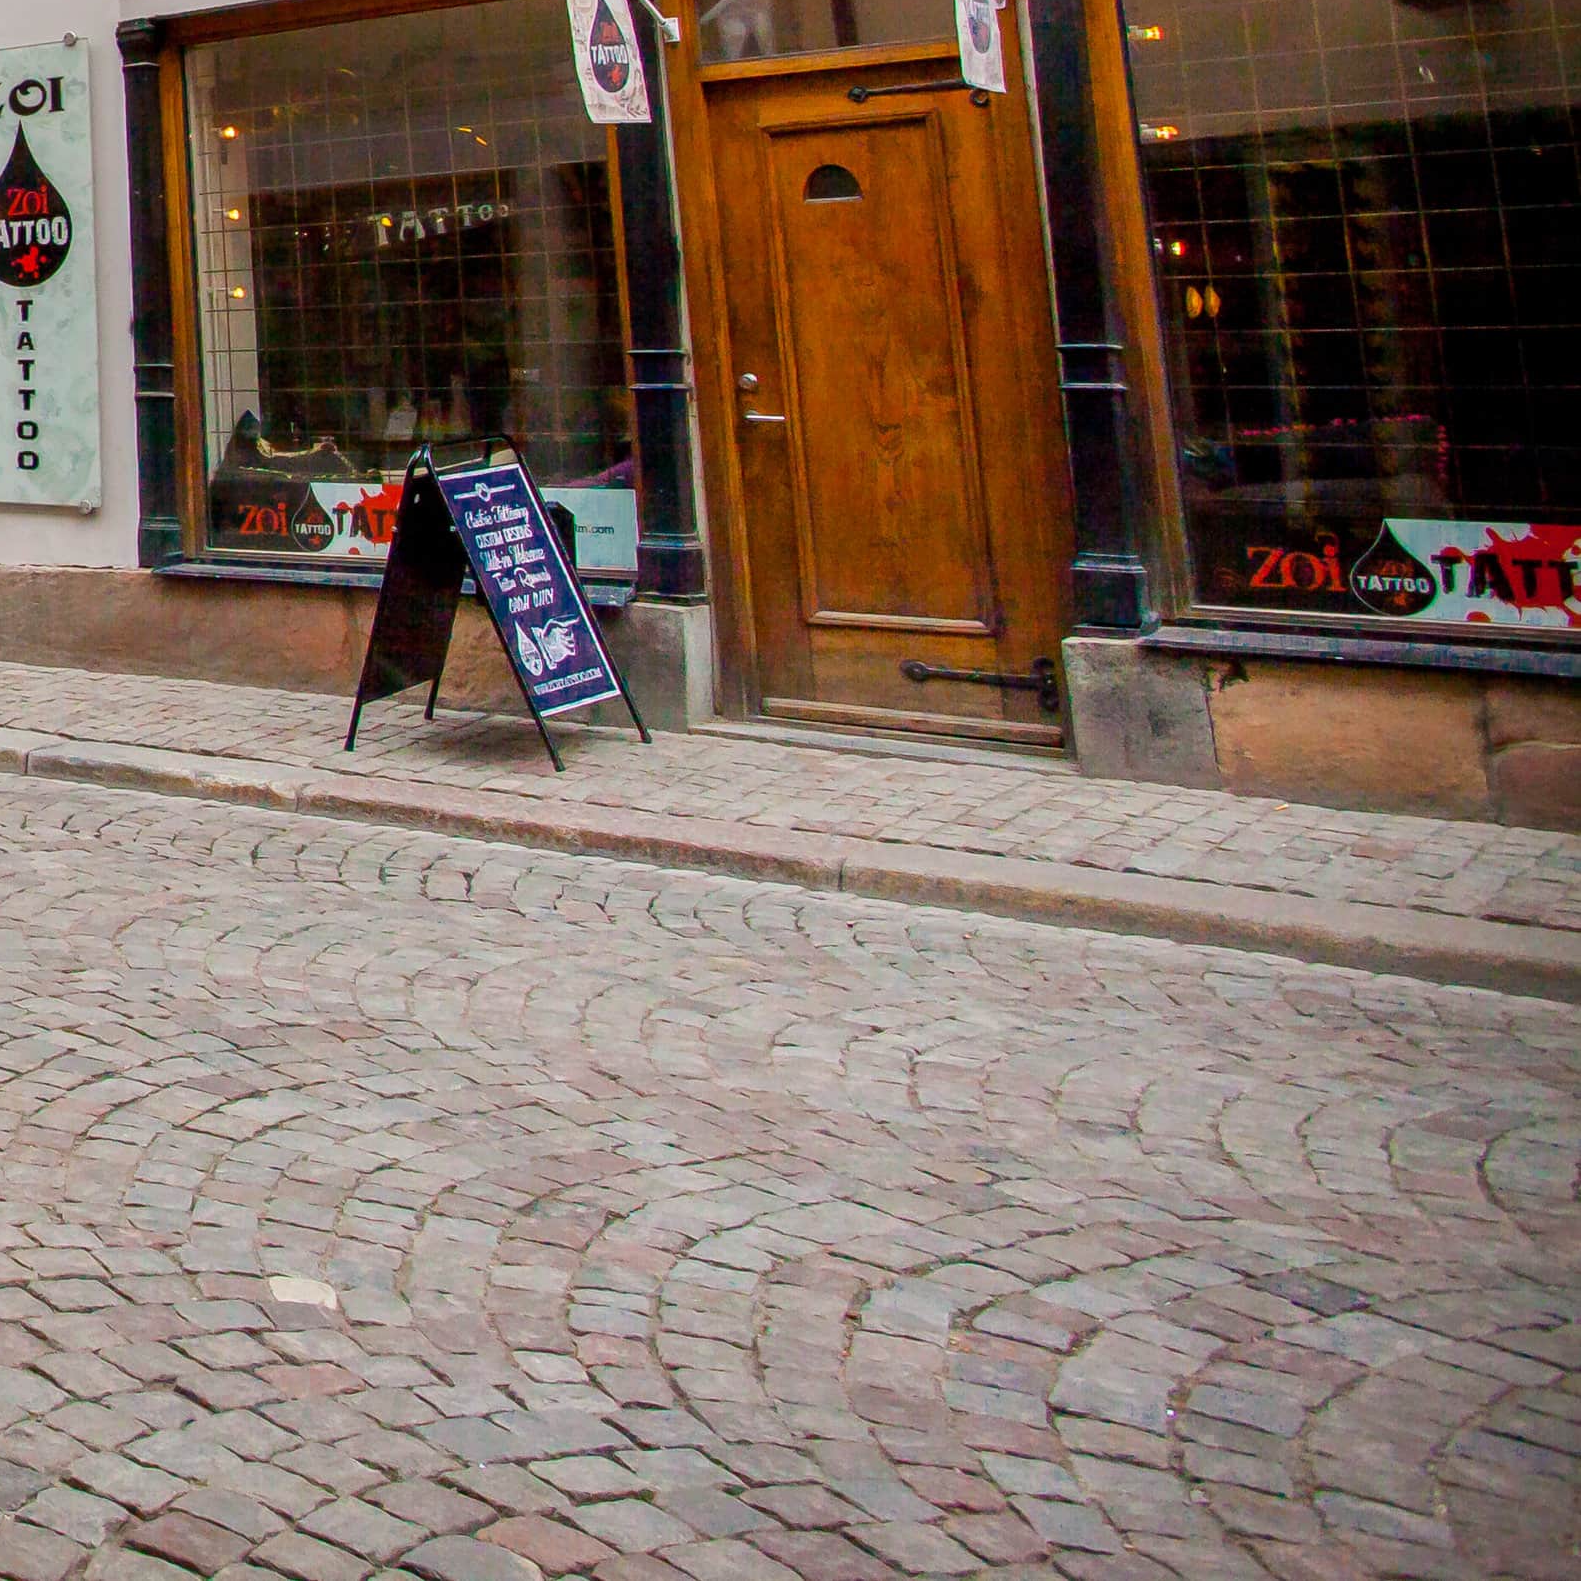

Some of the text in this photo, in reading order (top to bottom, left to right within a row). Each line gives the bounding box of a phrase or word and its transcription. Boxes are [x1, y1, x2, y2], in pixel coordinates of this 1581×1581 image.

[590, 44, 628, 66] TATTOO
[6, 184, 49, 216] Zoi
[372, 204, 509, 248] TATTOO
[16, 299, 39, 470] TATTOO
[239, 502, 288, 537] Zoi
[295, 523, 331, 536] TATTOO
[1246, 543, 1346, 593] Zoi
[1356, 574, 1430, 595] TATTOO
